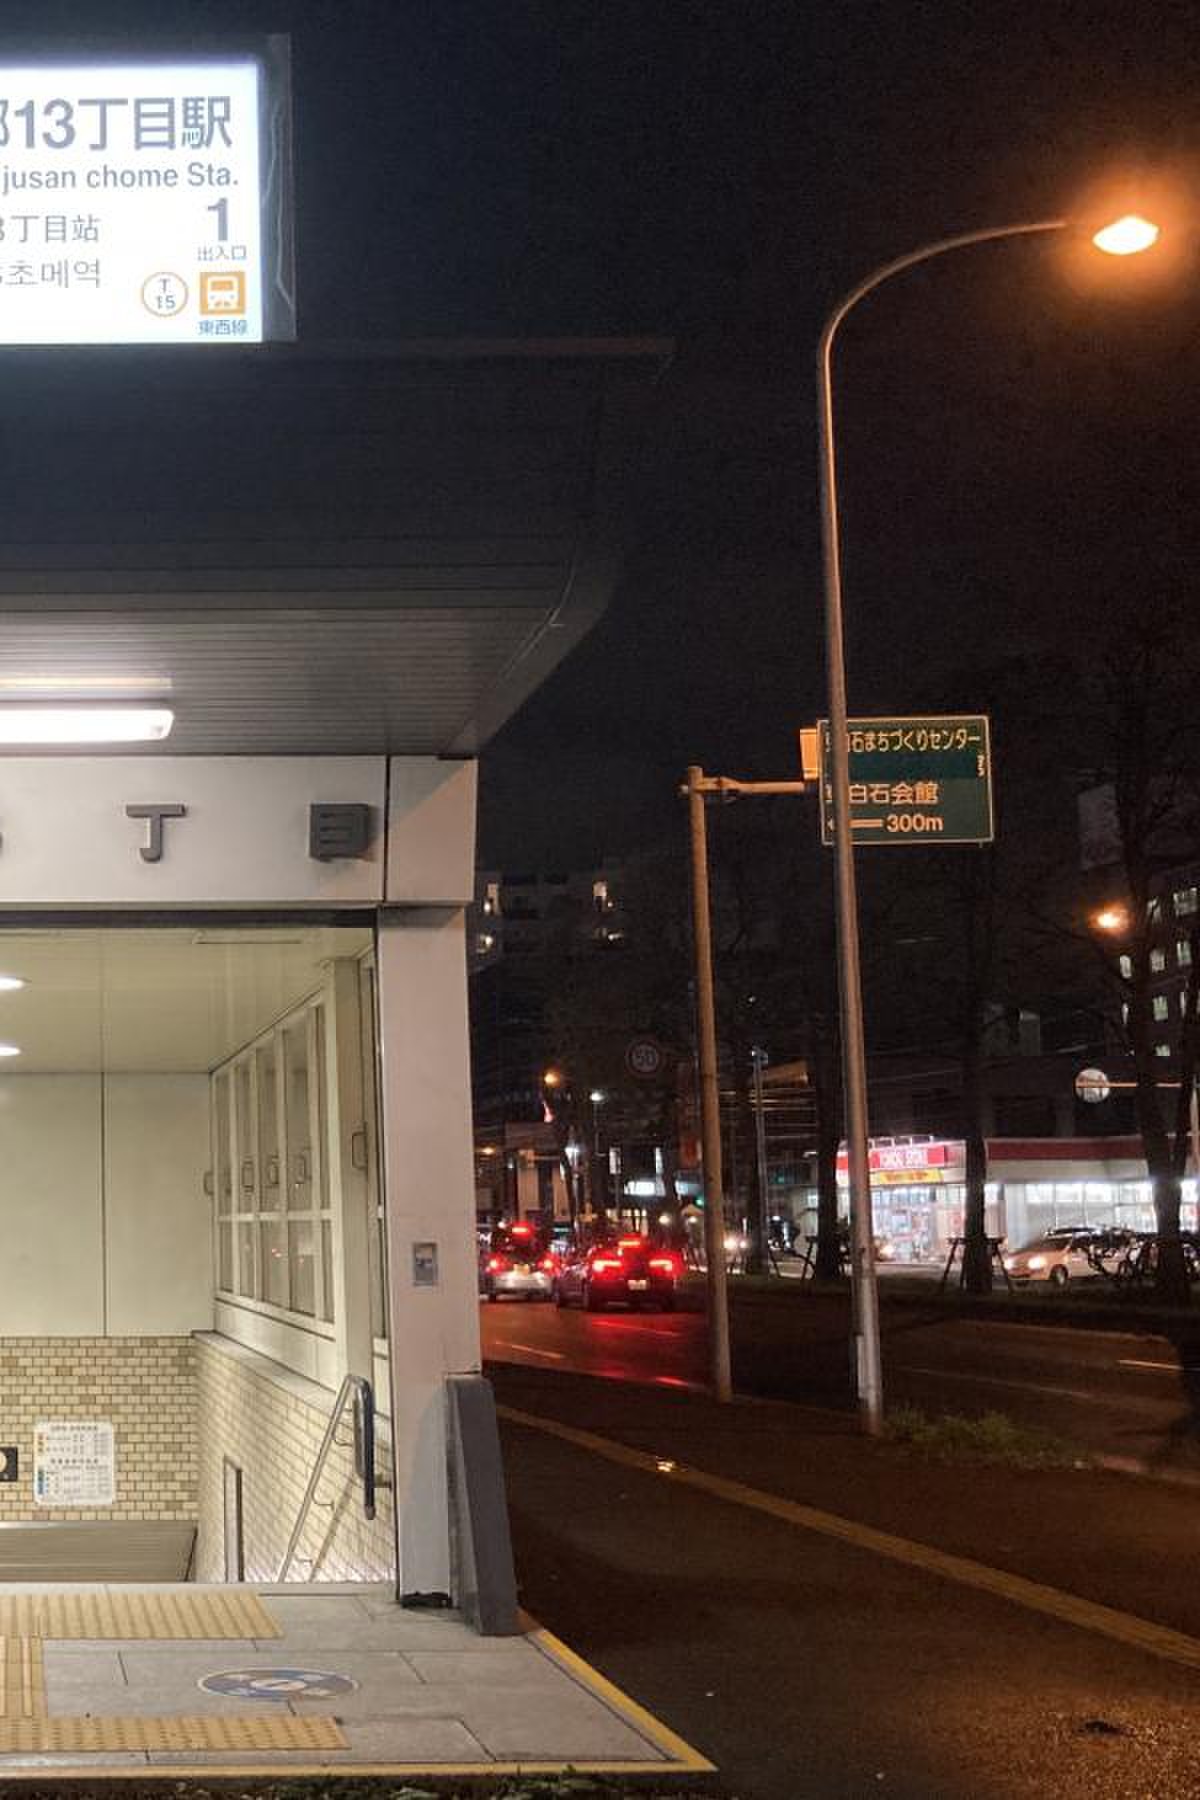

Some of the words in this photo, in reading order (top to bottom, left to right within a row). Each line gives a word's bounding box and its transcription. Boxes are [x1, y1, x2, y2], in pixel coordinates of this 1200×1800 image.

[1, 165, 77, 196] jusan
[86, 164, 179, 188] chome
[187, 162, 239, 187] Sta.
[206, 197, 228, 242] 1
[197, 244, 247, 262] 出入口
[158, 278, 171, 294] T
[886, 814, 944, 833] 300m
